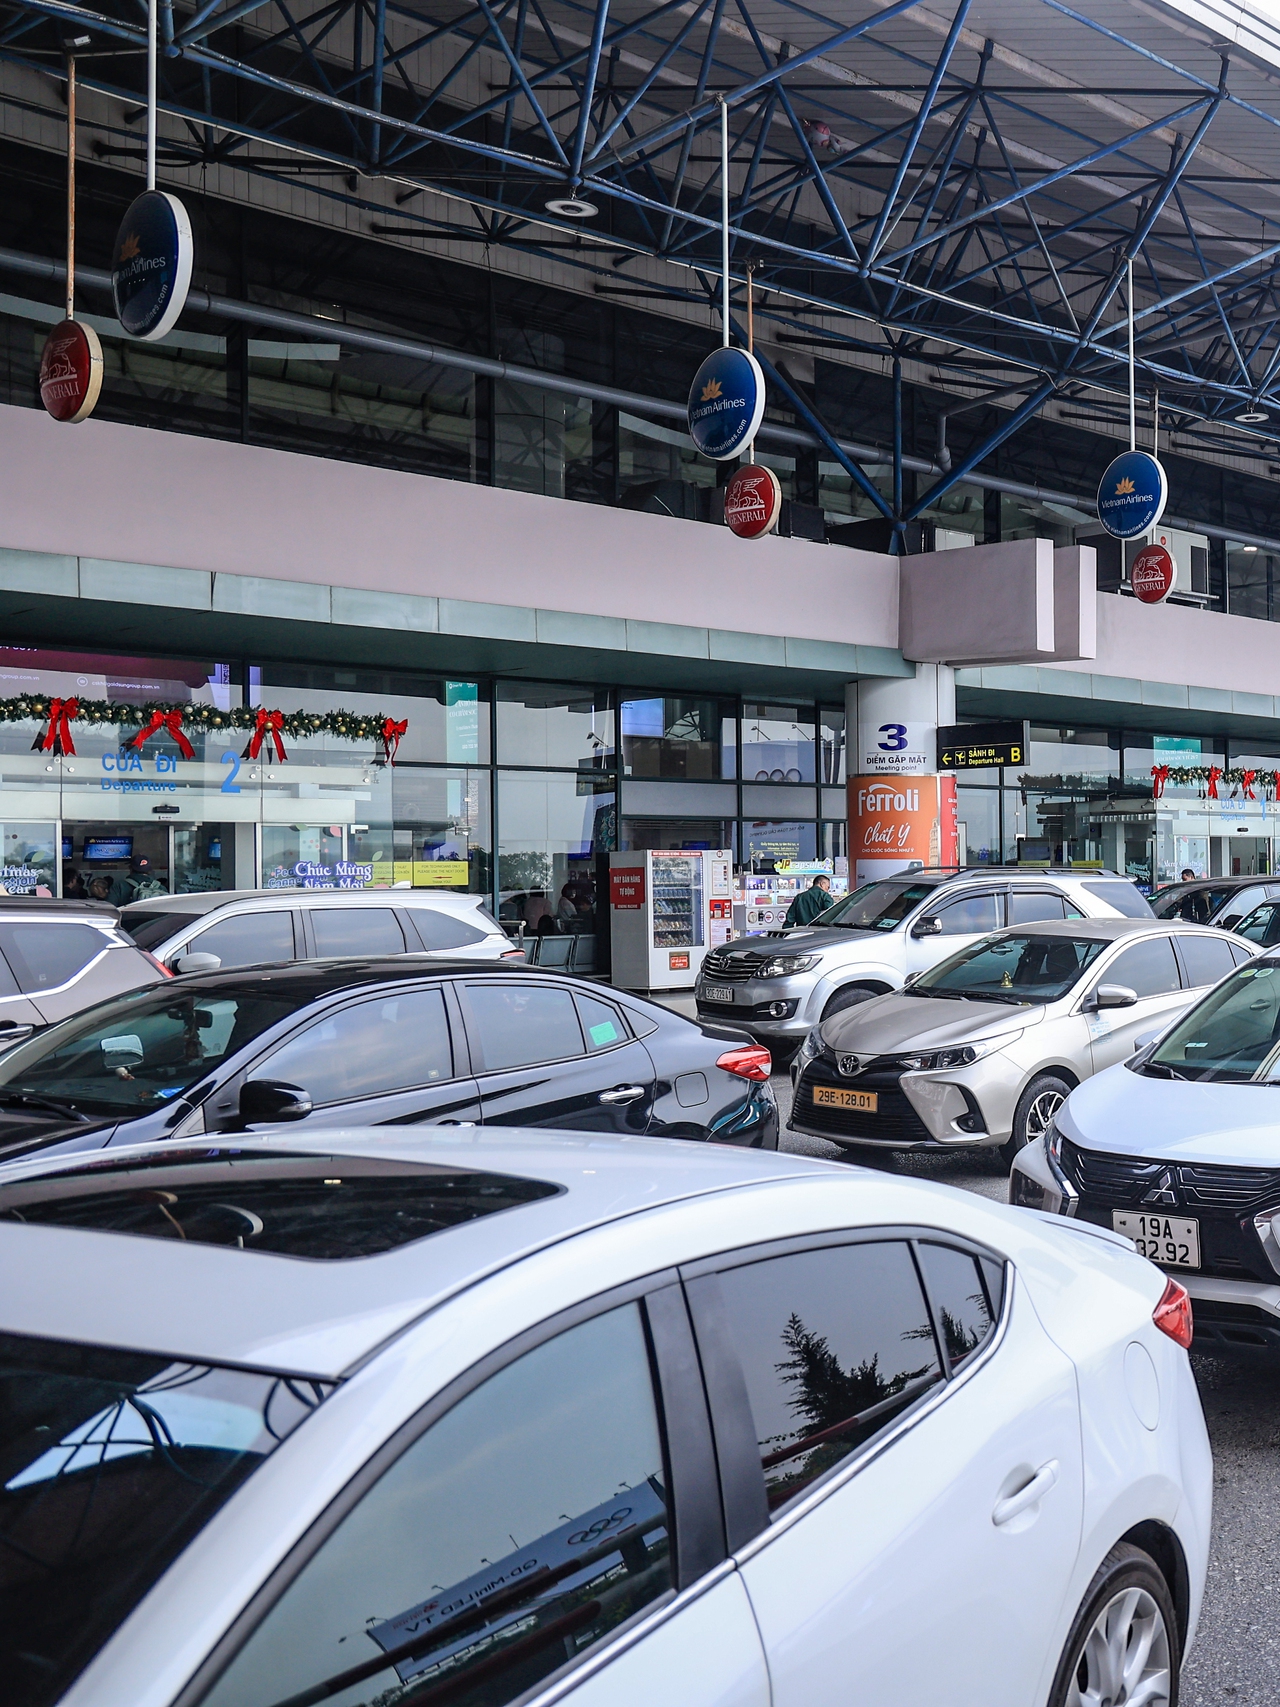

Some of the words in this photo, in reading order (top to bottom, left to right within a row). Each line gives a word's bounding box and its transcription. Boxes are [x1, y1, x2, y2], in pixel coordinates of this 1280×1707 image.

[713, 398, 745, 411] Airlines
[1102, 499, 1126, 508] Vietnam
[1126, 494, 1153, 504] Airlines
[728, 510, 766, 524] GENERALI
[1135, 582, 1165, 592] GENERALI
[878, 724, 908, 750] 3
[888, 756, 906, 766] GẶP
[909, 756, 926, 765] MẶT
[969, 749, 986, 757] SẢNH
[1011, 748, 1021, 762] B
[102, 747, 142, 772] CỬA
[156, 755, 176, 772] ĐI
[221, 751, 241, 793] 2
[101, 778, 176, 793] Departure
[1260, 797, 1266, 820] 1
[864, 822, 895, 845] Chất
[295, 862, 332, 876] Chúc
[336, 862, 372, 880] Mừng
[819, 1090, 870, 1108] 29E-128.01
[1139, 1216, 1173, 1239] 19A
[1134, 1238, 1190, 1264] 32.92
